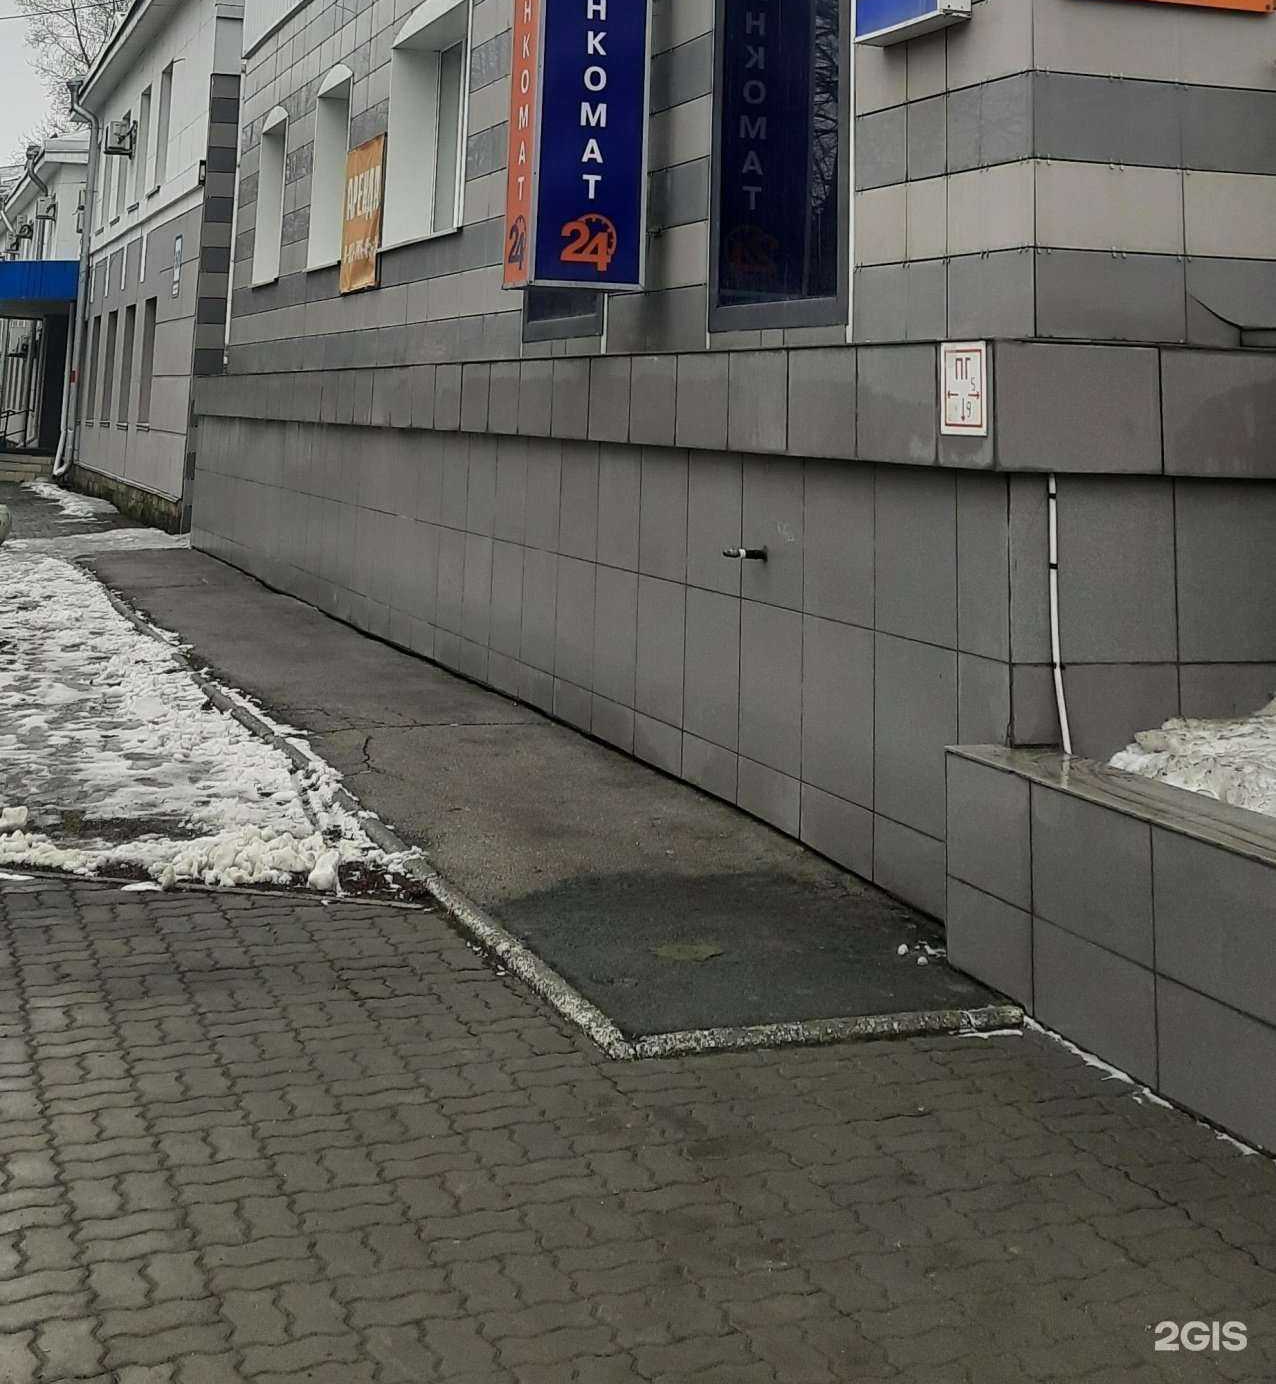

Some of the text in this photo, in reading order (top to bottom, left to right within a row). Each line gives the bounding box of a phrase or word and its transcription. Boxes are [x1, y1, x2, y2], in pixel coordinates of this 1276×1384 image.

[345, 165, 382, 221] АРЕНДА
[508, 223, 527, 271] 24
[560, 220, 613, 272] 24
[955, 357, 971, 380] ПГ
